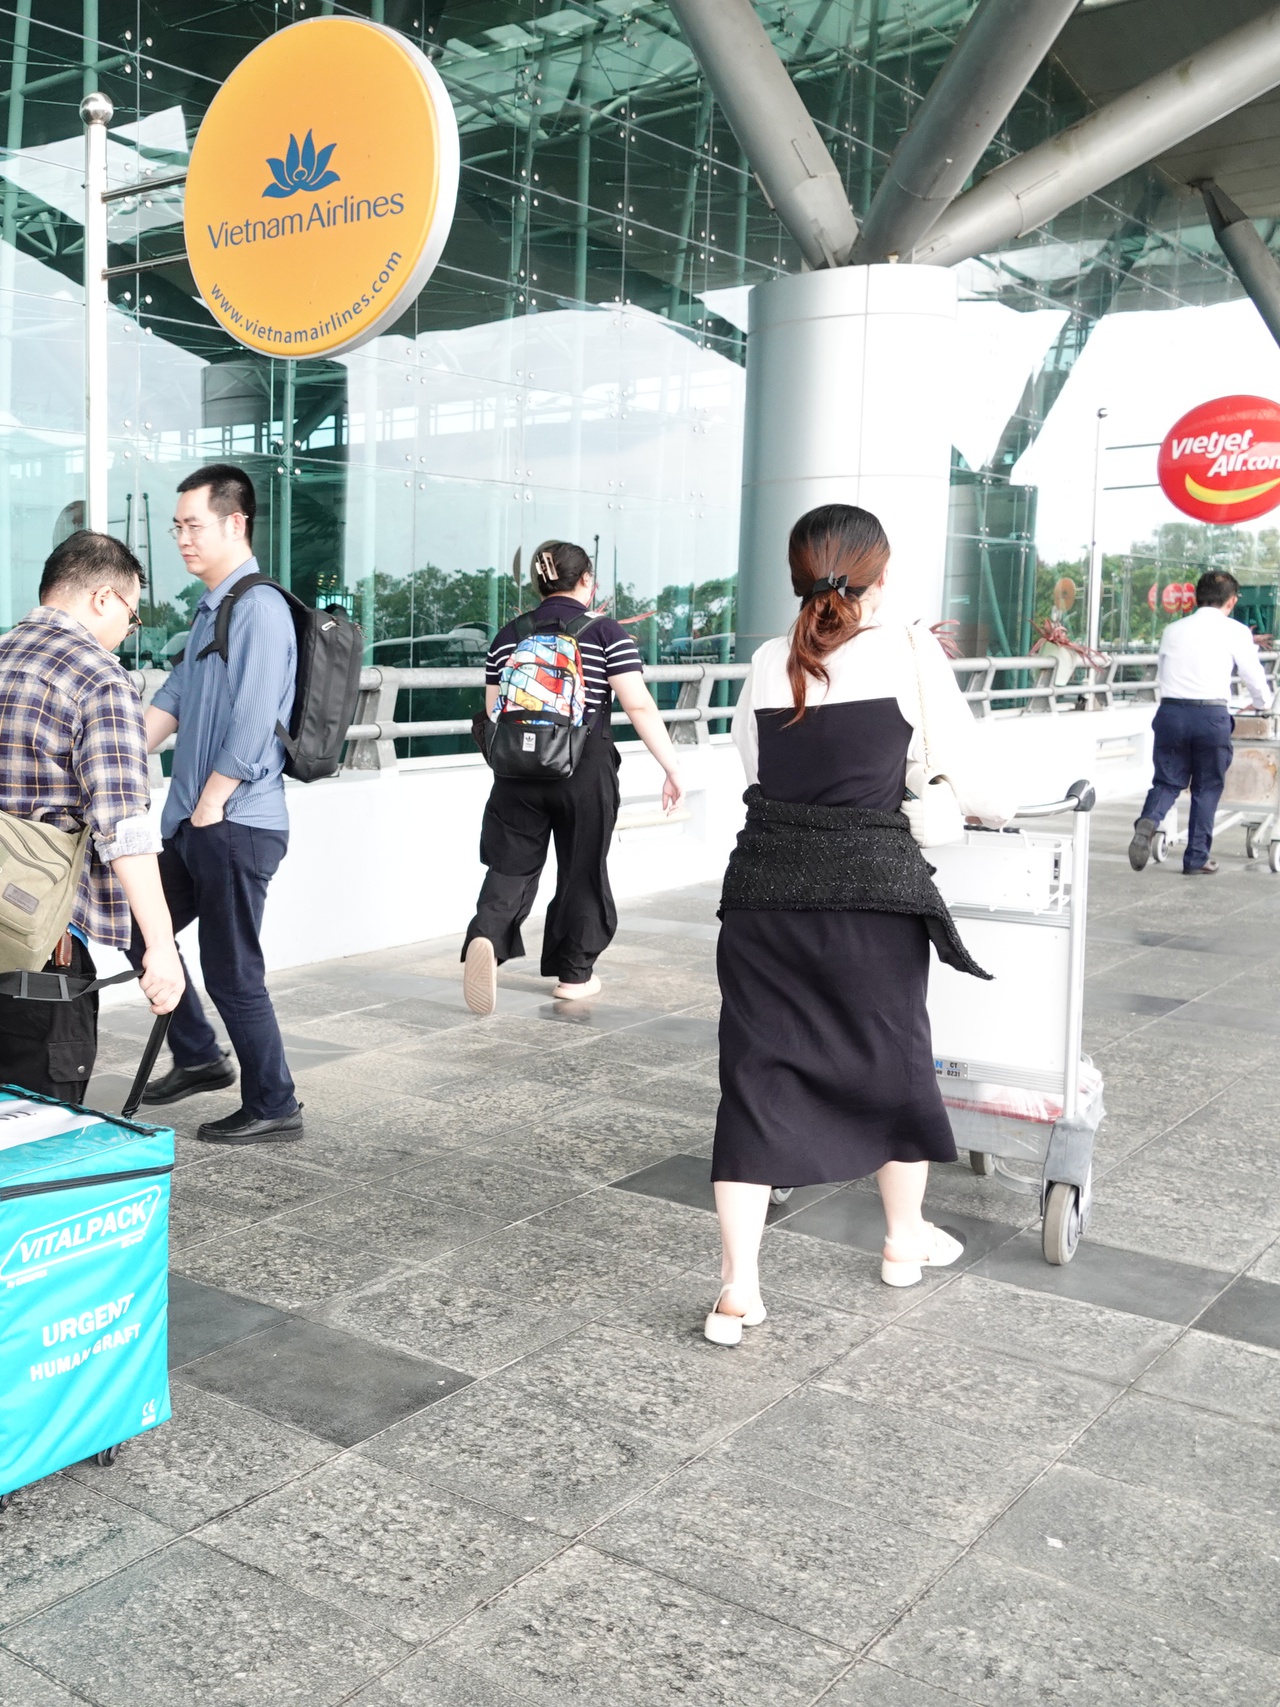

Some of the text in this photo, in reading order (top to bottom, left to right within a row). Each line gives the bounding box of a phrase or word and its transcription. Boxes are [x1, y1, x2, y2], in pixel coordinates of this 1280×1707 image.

[207, 192, 405, 250] Vietnam Airlines
[211, 250, 402, 344] www.vietnamairlines.com
[20, 1200, 147, 1263] VITALPACK
[42, 1292, 135, 1348] URGENT
[30, 1322, 142, 1382] HUMAN GRAFT
